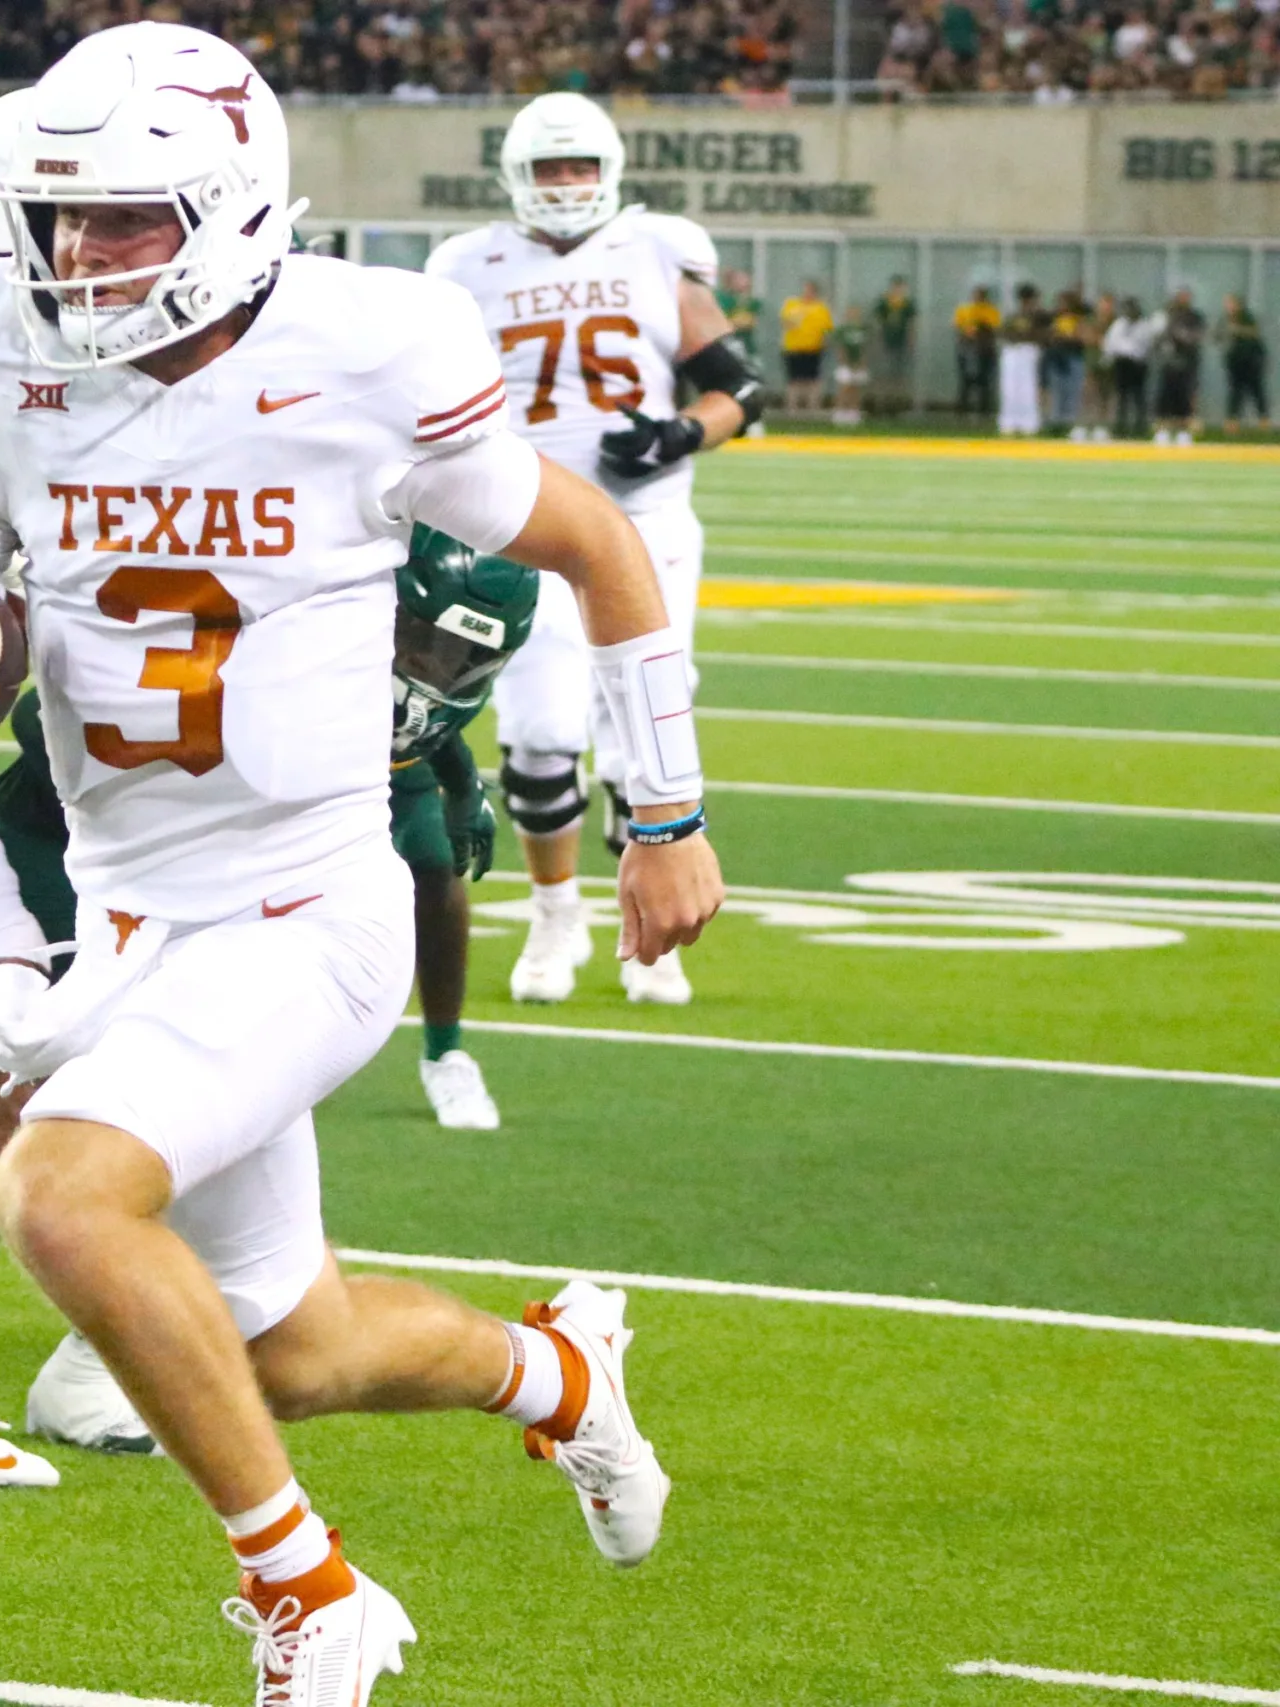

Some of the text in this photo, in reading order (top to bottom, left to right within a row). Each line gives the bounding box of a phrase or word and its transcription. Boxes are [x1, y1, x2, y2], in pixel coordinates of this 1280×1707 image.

[1126, 136, 1215, 181] BIG
[504, 279, 630, 320] TEXAS
[18, 380, 70, 413] XII
[499, 314, 646, 425] 76
[47, 483, 295, 557] TEXAS
[83, 565, 243, 778] 3
